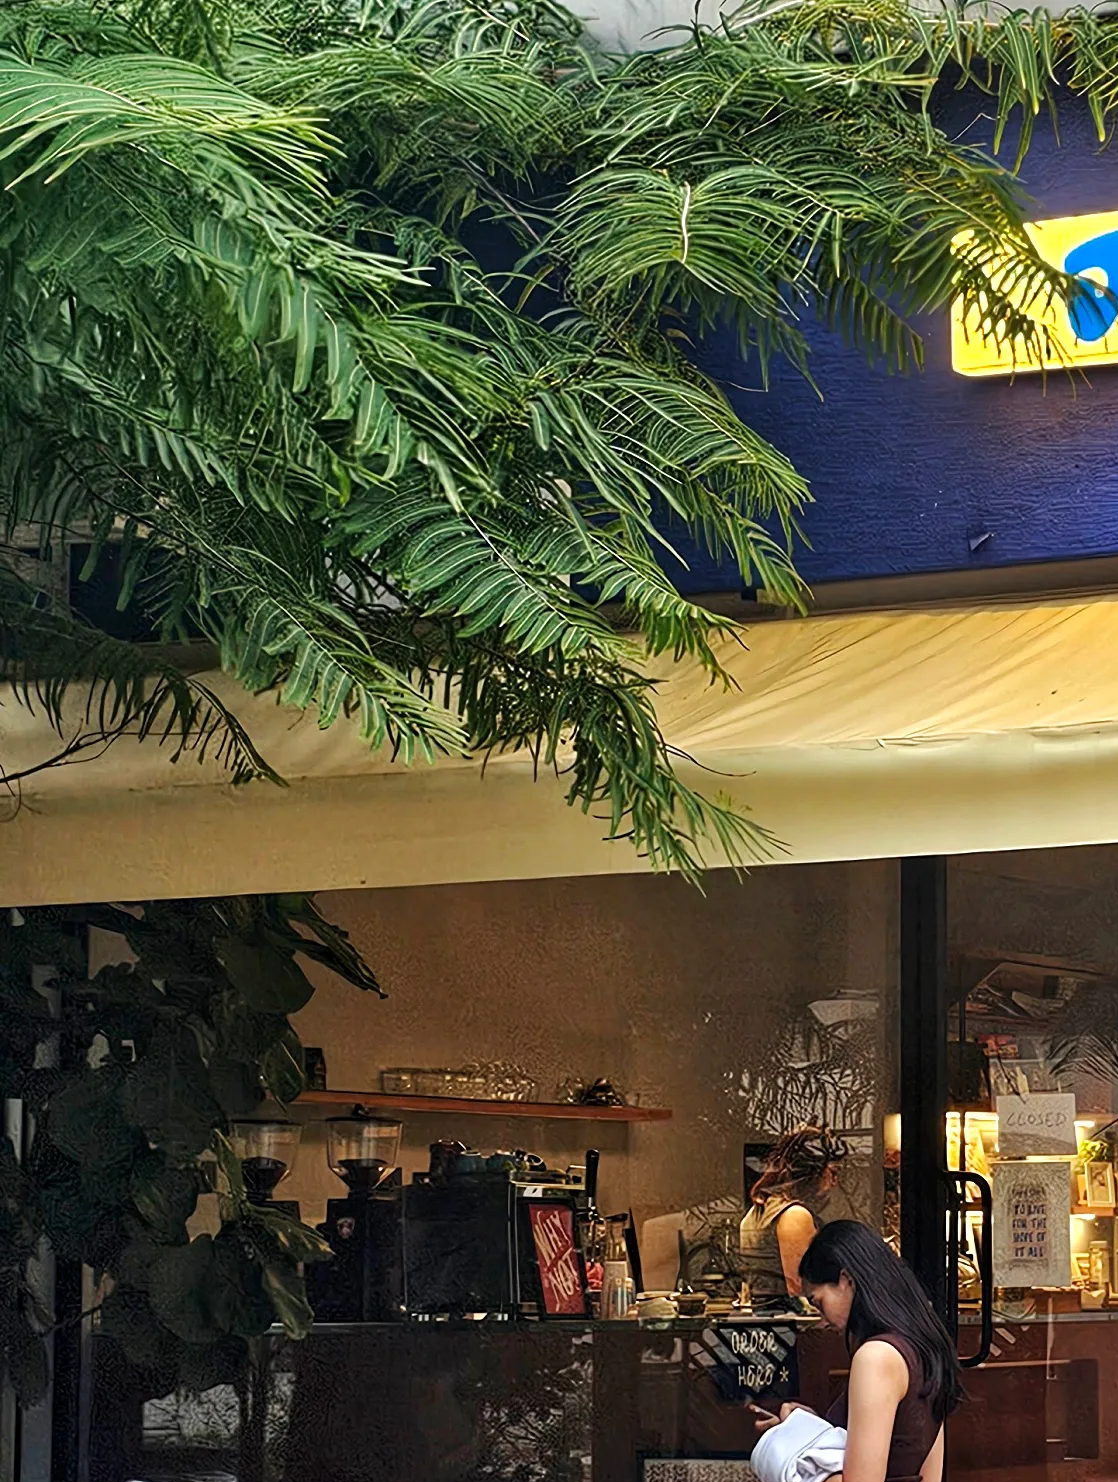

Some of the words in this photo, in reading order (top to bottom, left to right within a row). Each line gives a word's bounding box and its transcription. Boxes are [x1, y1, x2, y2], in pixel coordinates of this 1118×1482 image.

[1006, 1111, 1068, 1128] CLOSED
[548, 1247, 580, 1312] NOT
[731, 1330, 778, 1354] ORDER
